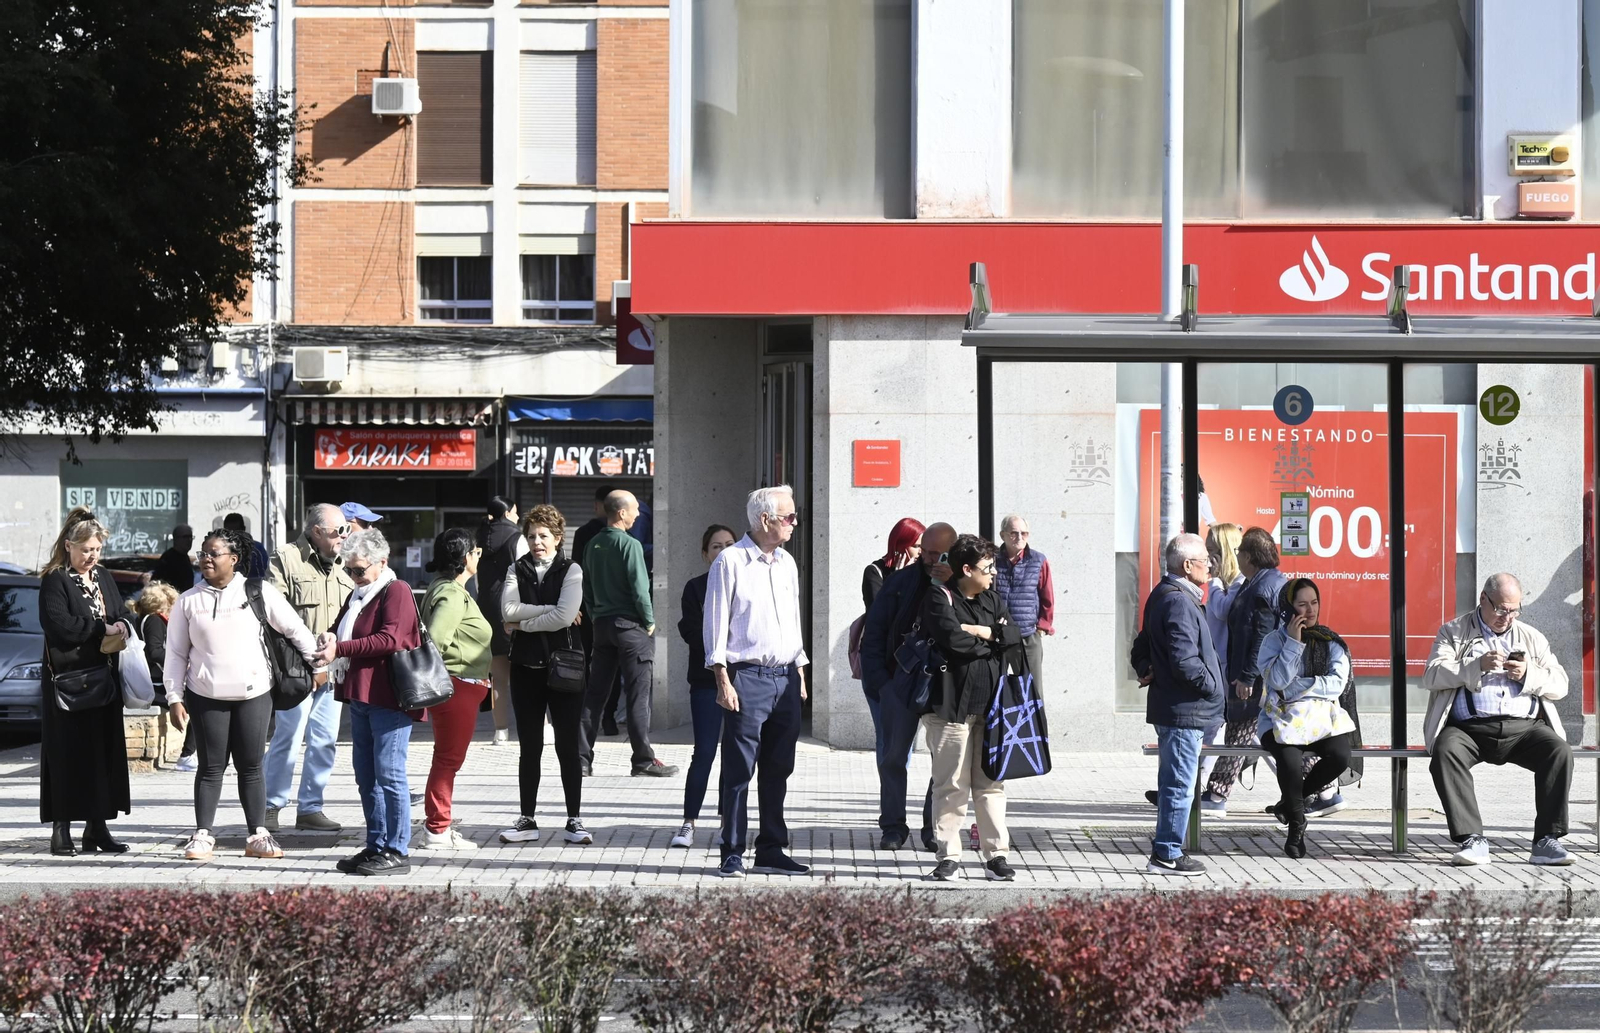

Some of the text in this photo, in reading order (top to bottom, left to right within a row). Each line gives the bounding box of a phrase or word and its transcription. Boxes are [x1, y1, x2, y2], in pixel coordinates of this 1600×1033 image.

[1526, 193, 1569, 203] FUEGO
[1361, 252, 1595, 301] Santand
[1285, 392, 1302, 417] 6
[1482, 392, 1515, 417] 12
[1224, 427, 1374, 443] BIENESTANDO
[343, 442, 431, 467] SARAKA
[527, 446, 594, 475] BLACK
[70, 490, 180, 508] SE VENDE
[1306, 485, 1354, 498] Nómina
[1256, 507, 1275, 515] Hasta
[1317, 571, 1325, 579] tu
[1326, 571, 1355, 580] nómina
[1356, 573, 1361, 582] y
[1362, 572, 1376, 580] dos
